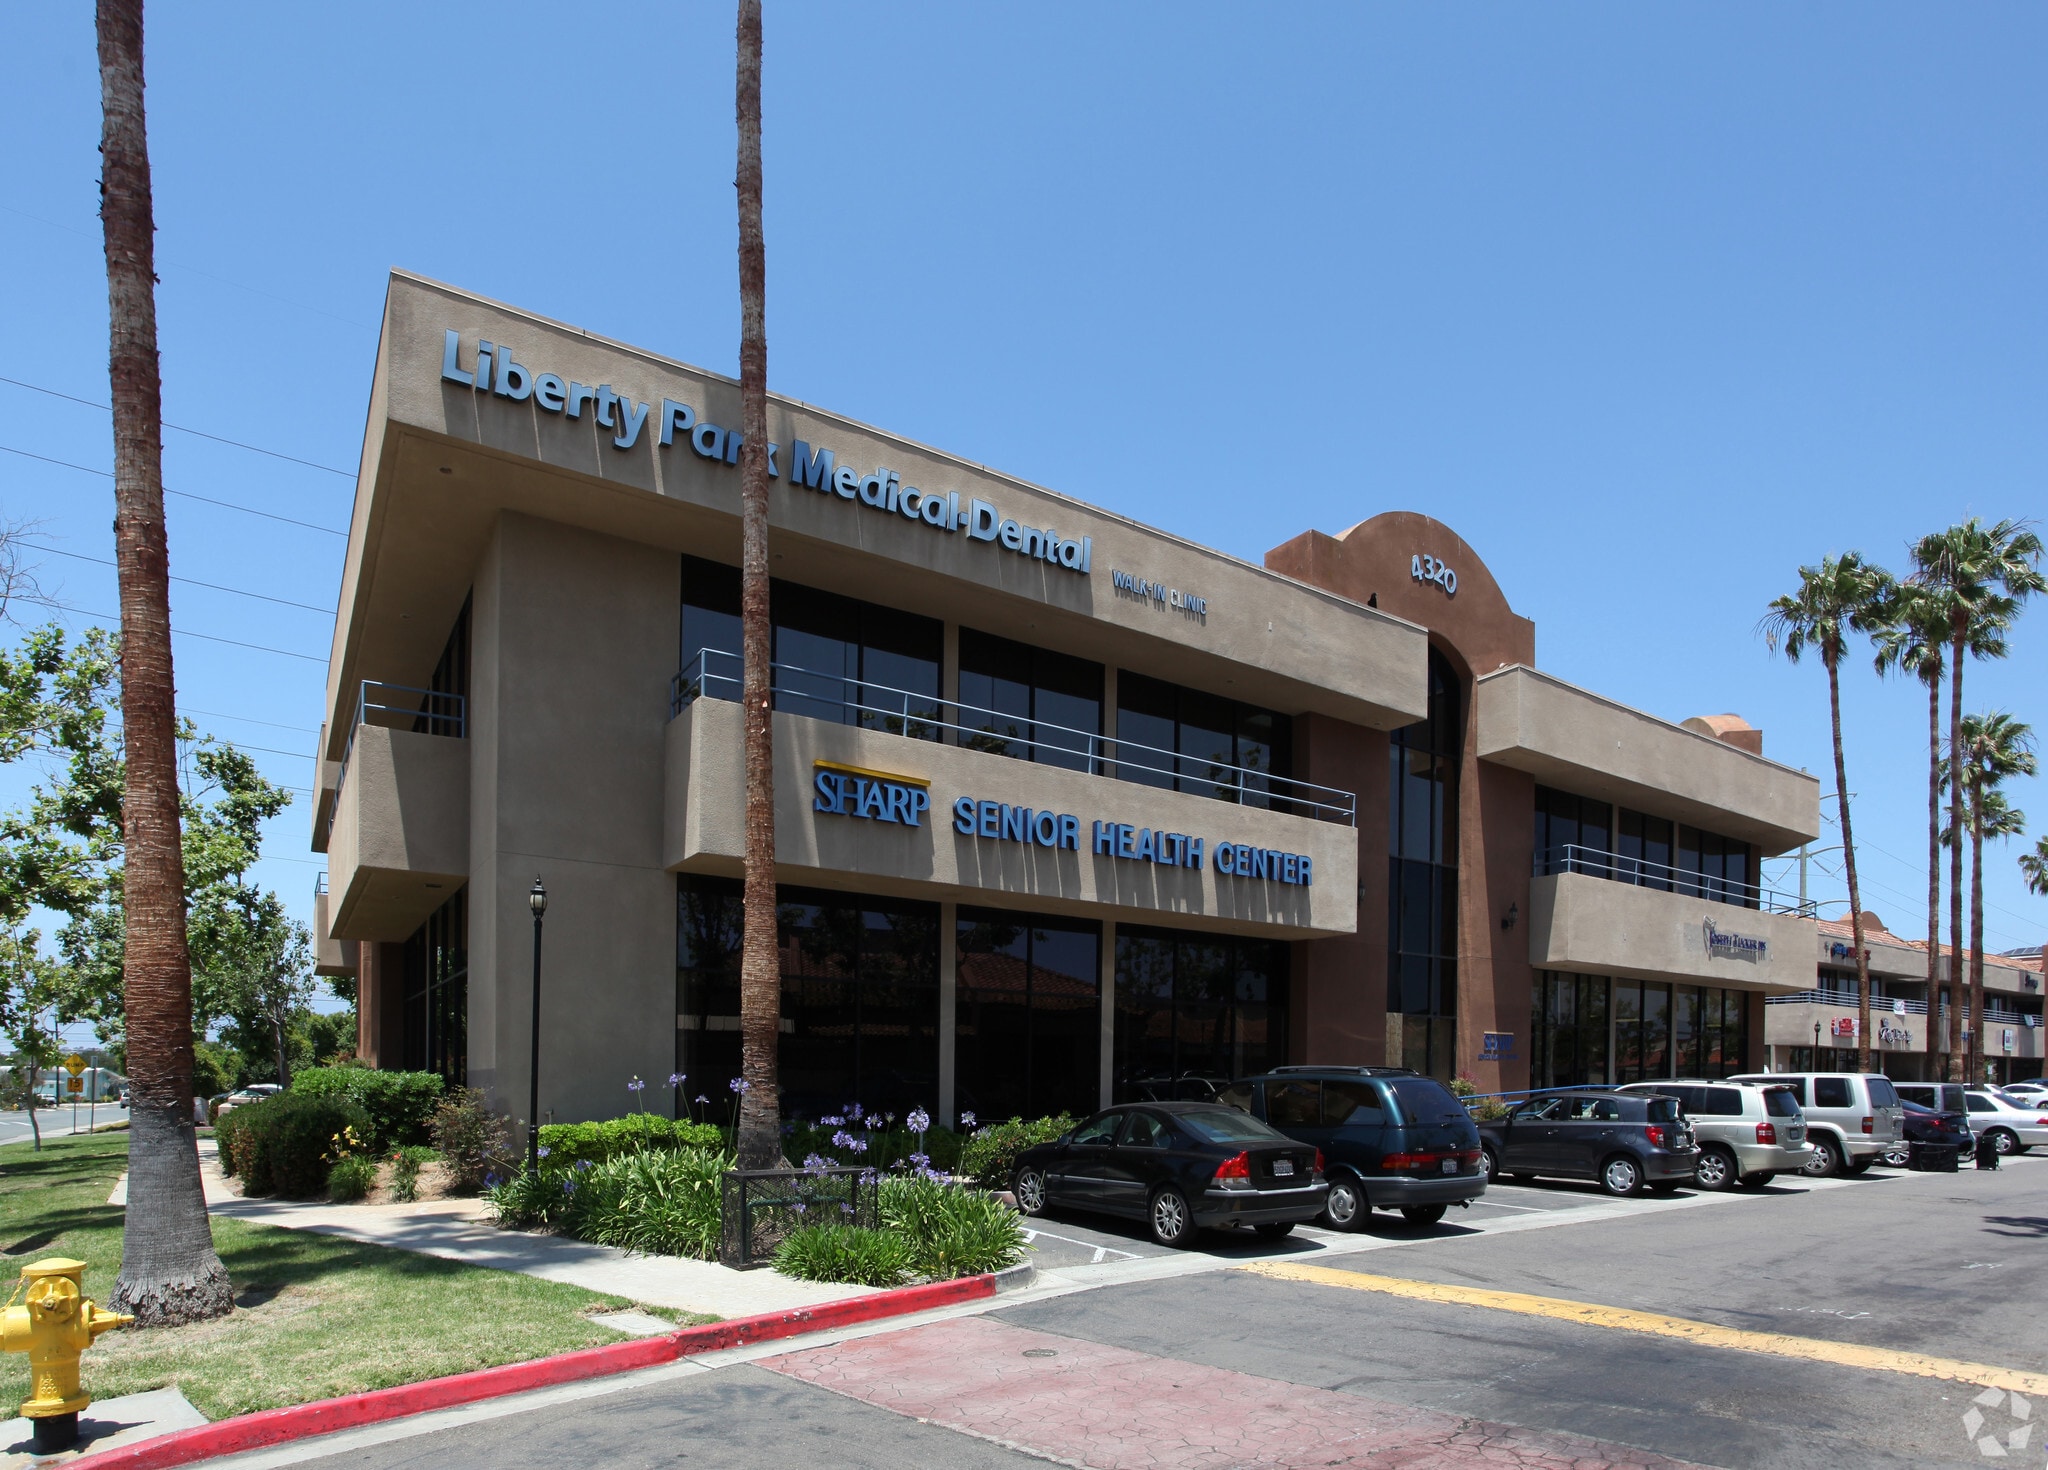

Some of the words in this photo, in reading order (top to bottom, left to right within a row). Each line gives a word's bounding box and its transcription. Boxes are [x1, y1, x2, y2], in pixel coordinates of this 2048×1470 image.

[441, 328, 650, 451] Liberty
[1112, 569, 1167, 602] WALK-IN
[1170, 589, 1207, 615] CLINIC
[1411, 554, 1458, 594] 4320
[813, 769, 930, 827] SHARP
[953, 796, 1080, 851] SENIOR
[1092, 819, 1204, 870] HEALTH
[1213, 841, 1313, 886] CENTER
[69, 1079, 81, 1088] 15
